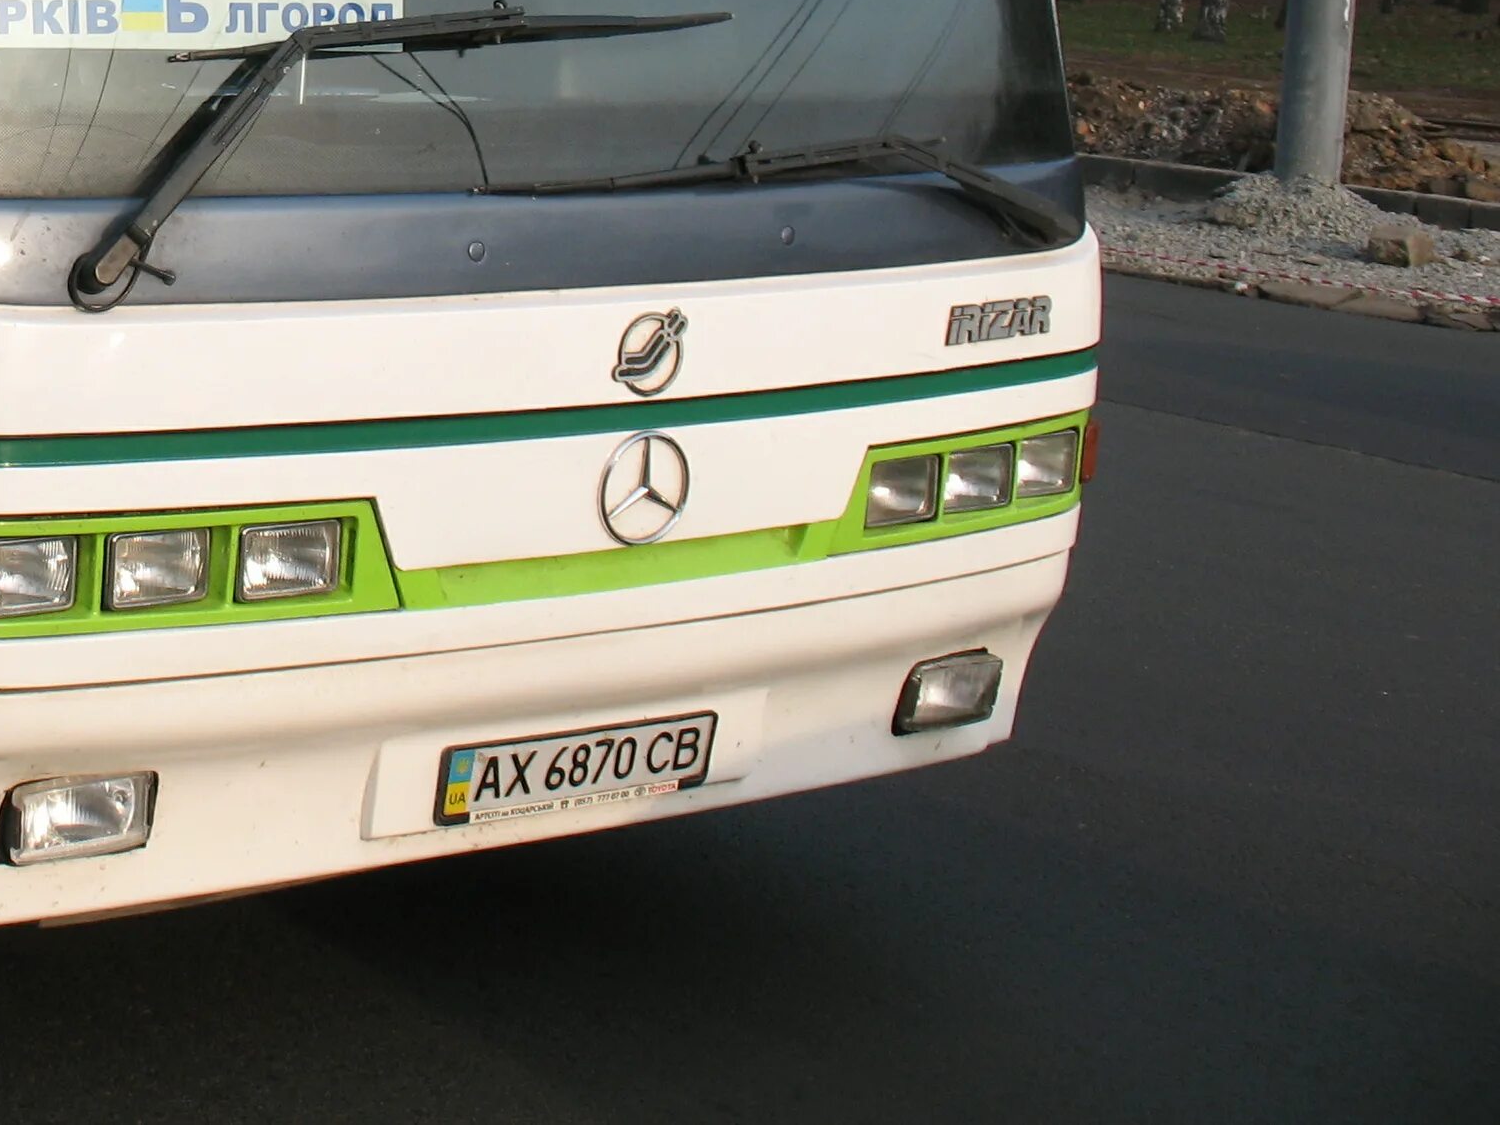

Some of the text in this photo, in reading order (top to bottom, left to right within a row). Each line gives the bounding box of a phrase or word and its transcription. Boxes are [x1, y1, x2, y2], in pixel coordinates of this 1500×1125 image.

[474, 727, 701, 802] AX 6870 CB
[448, 791, 466, 806] UA
